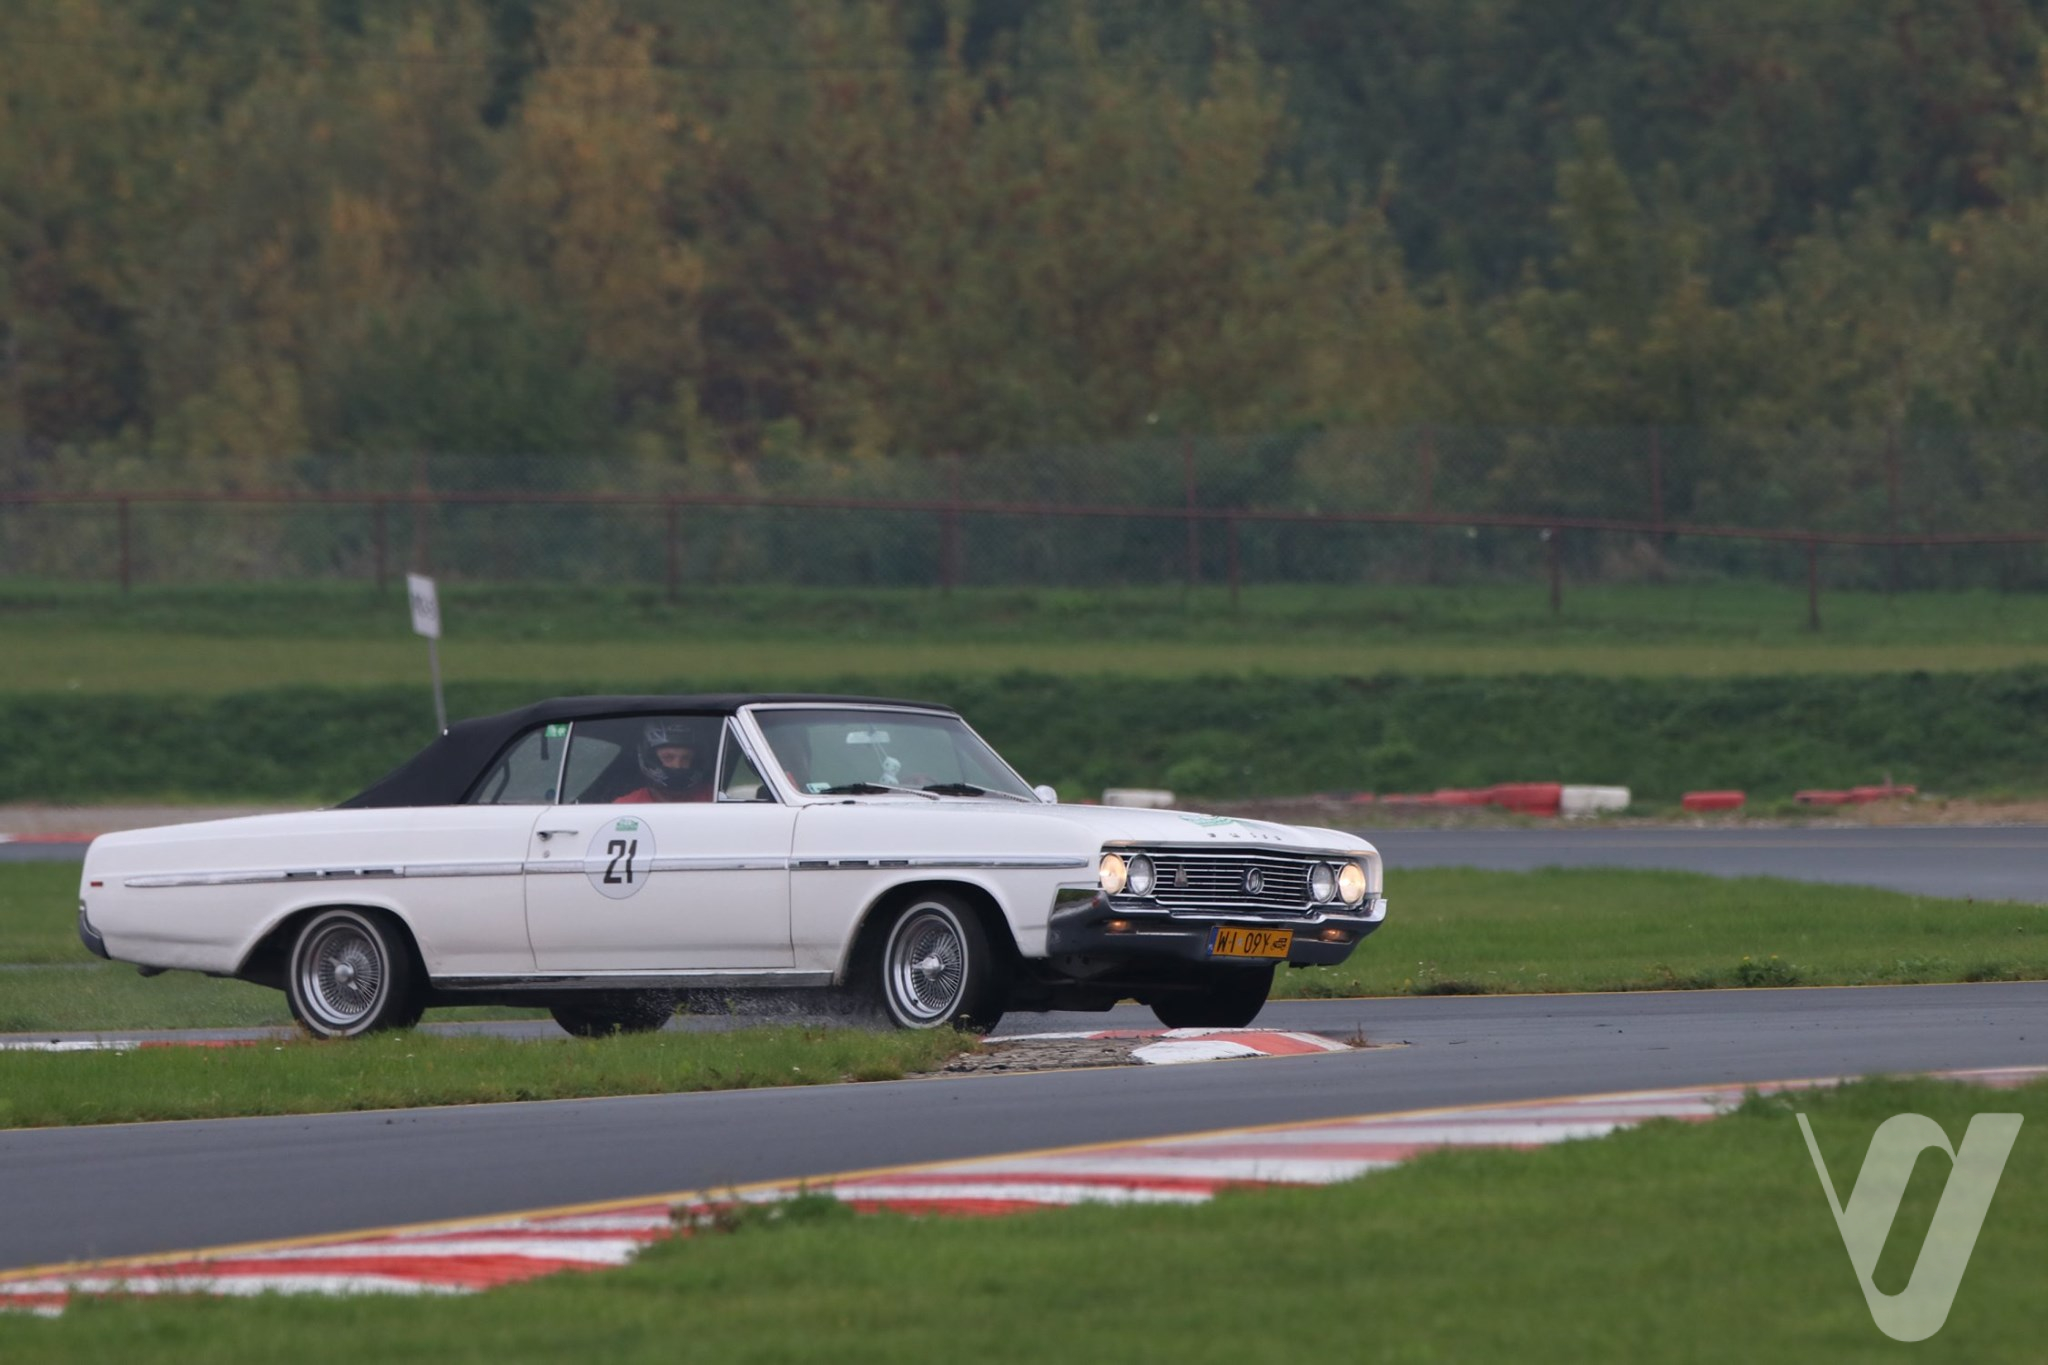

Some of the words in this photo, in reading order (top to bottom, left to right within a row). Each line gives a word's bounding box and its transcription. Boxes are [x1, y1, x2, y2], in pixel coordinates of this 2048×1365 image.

[603, 839, 638, 884] 21
[1216, 931, 1238, 953] WI
[1243, 932, 1272, 955] 09Y
